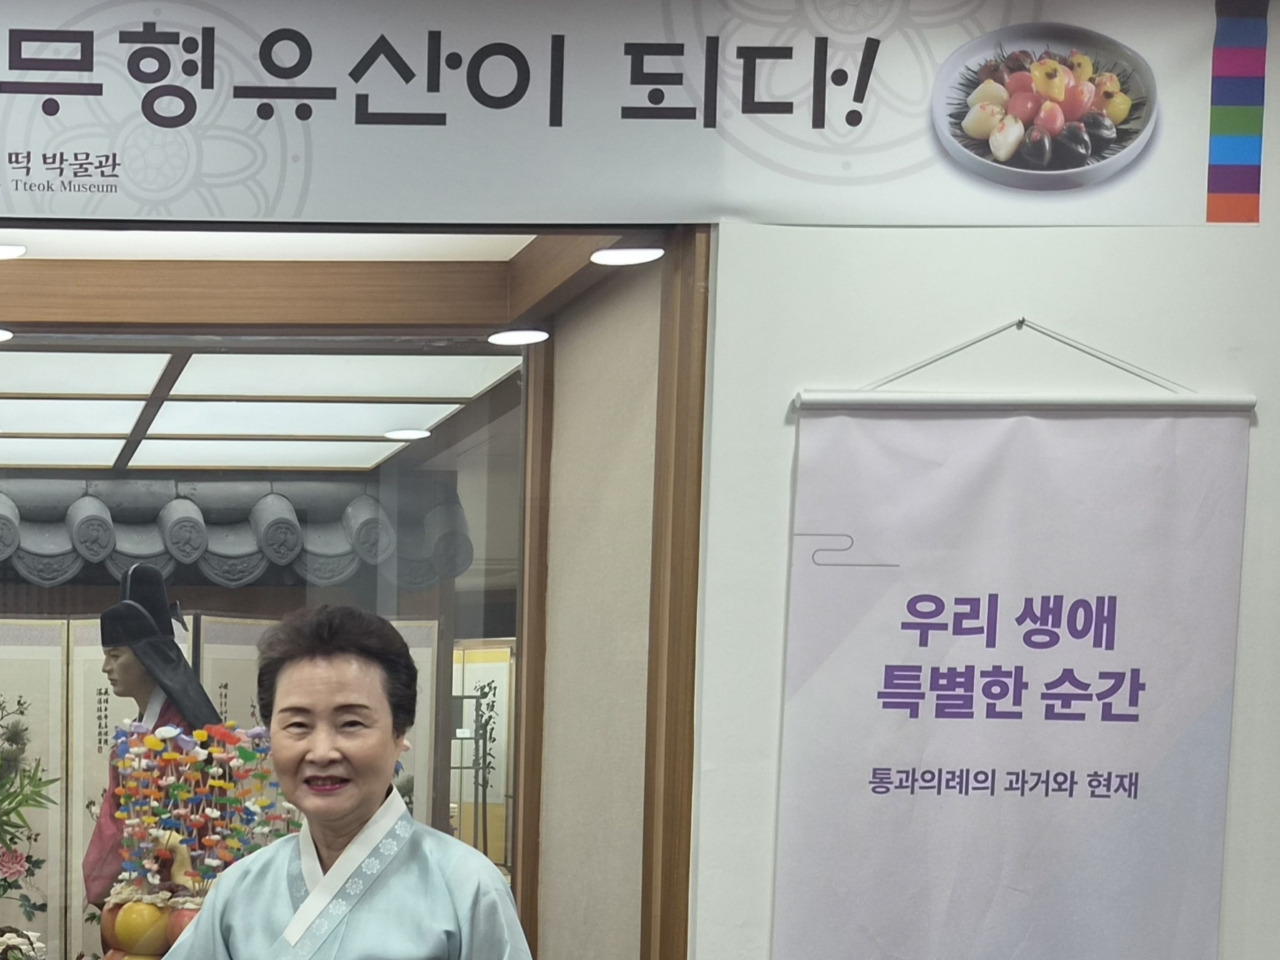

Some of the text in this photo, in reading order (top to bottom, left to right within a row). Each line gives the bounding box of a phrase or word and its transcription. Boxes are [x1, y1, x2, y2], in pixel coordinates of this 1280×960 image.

[621, 36, 881, 129] 되다!
[8, 151, 121, 177] 떡 박물관
[12, 180, 117, 193] Tteok Museum
[901, 594, 1117, 650] 우리 생애
[877, 665, 1146, 722] 특별한 순간
[869, 768, 1139, 799] 통과의례의 과거와 현재
